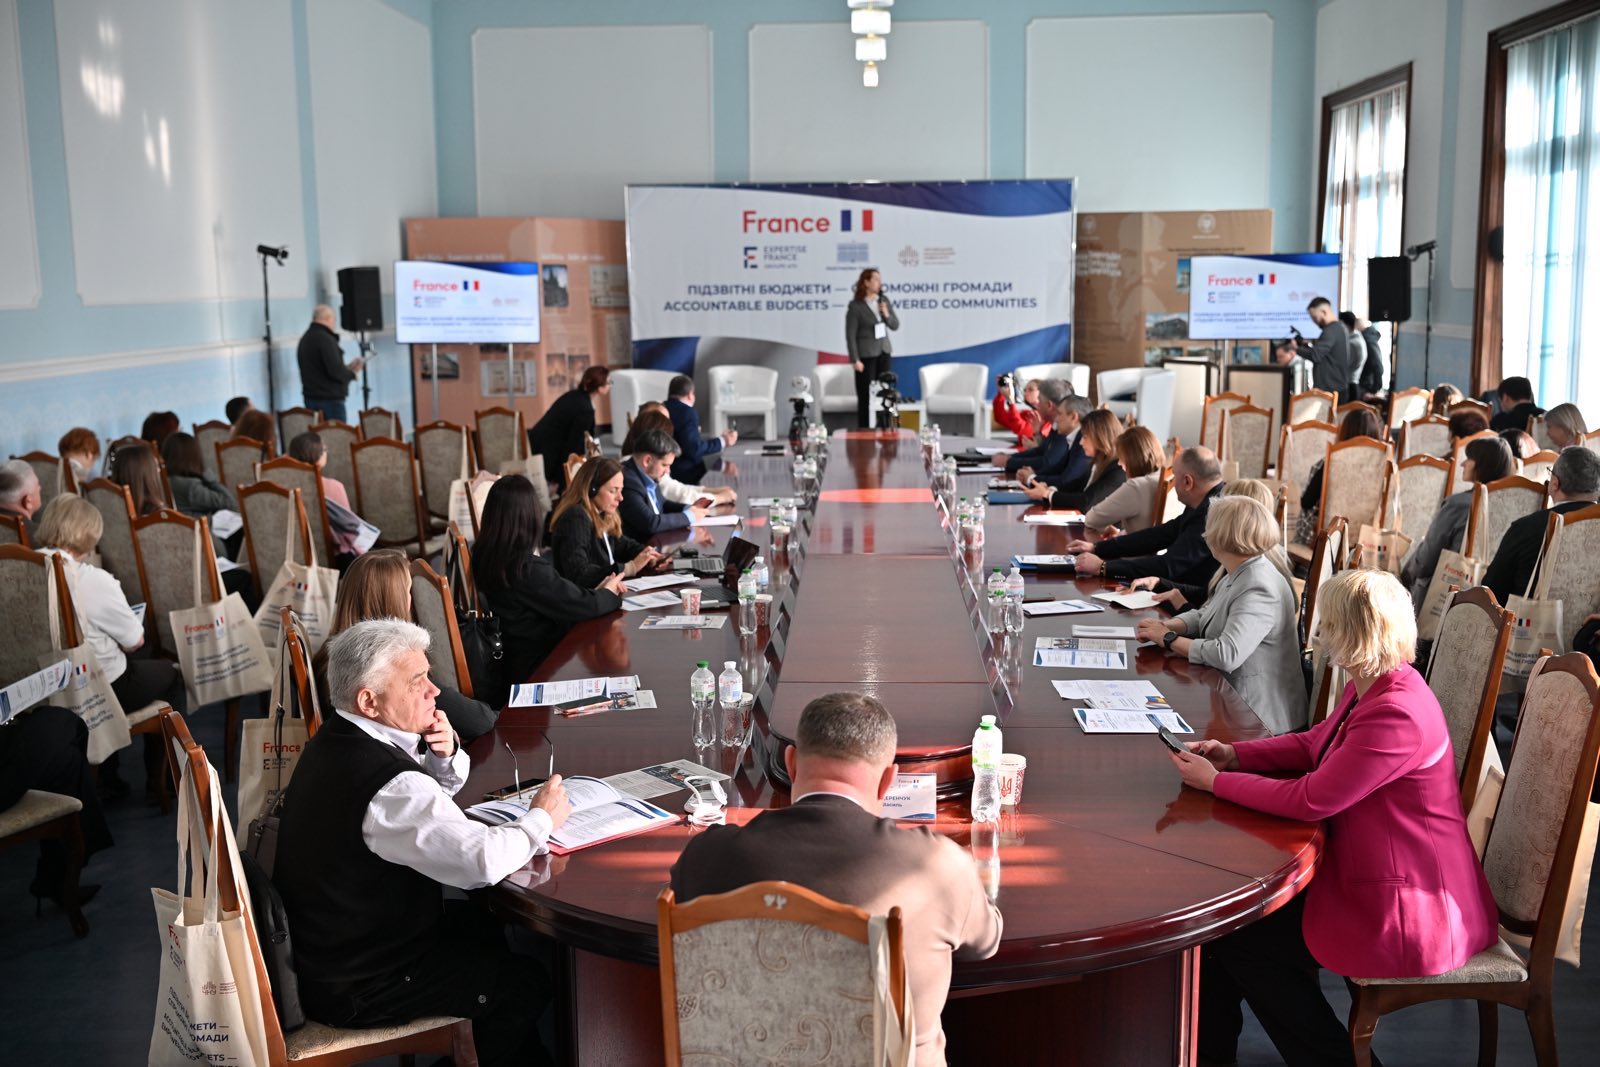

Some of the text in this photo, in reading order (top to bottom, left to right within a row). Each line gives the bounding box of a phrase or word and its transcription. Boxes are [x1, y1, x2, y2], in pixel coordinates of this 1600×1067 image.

[742, 210, 831, 234] France
[763, 245, 807, 254] EXPERTISE
[413, 280, 459, 292] France
[1207, 274, 1254, 287] France
[687, 284, 756, 297] ПІДЗВІТНІ
[759, 283, 832, 296] БЮДЖЕТИ
[850, 282, 939, 294] СОМОЖНІ
[942, 282, 1013, 294] ГРОМАДИ
[663, 300, 763, 312] ACCOUNTABLE
[765, 299, 830, 311] BUDGETS
[888, 298, 938, 310] WERED
[941, 297, 1038, 310] COMMUNITIES
[184, 623, 215, 633] France
